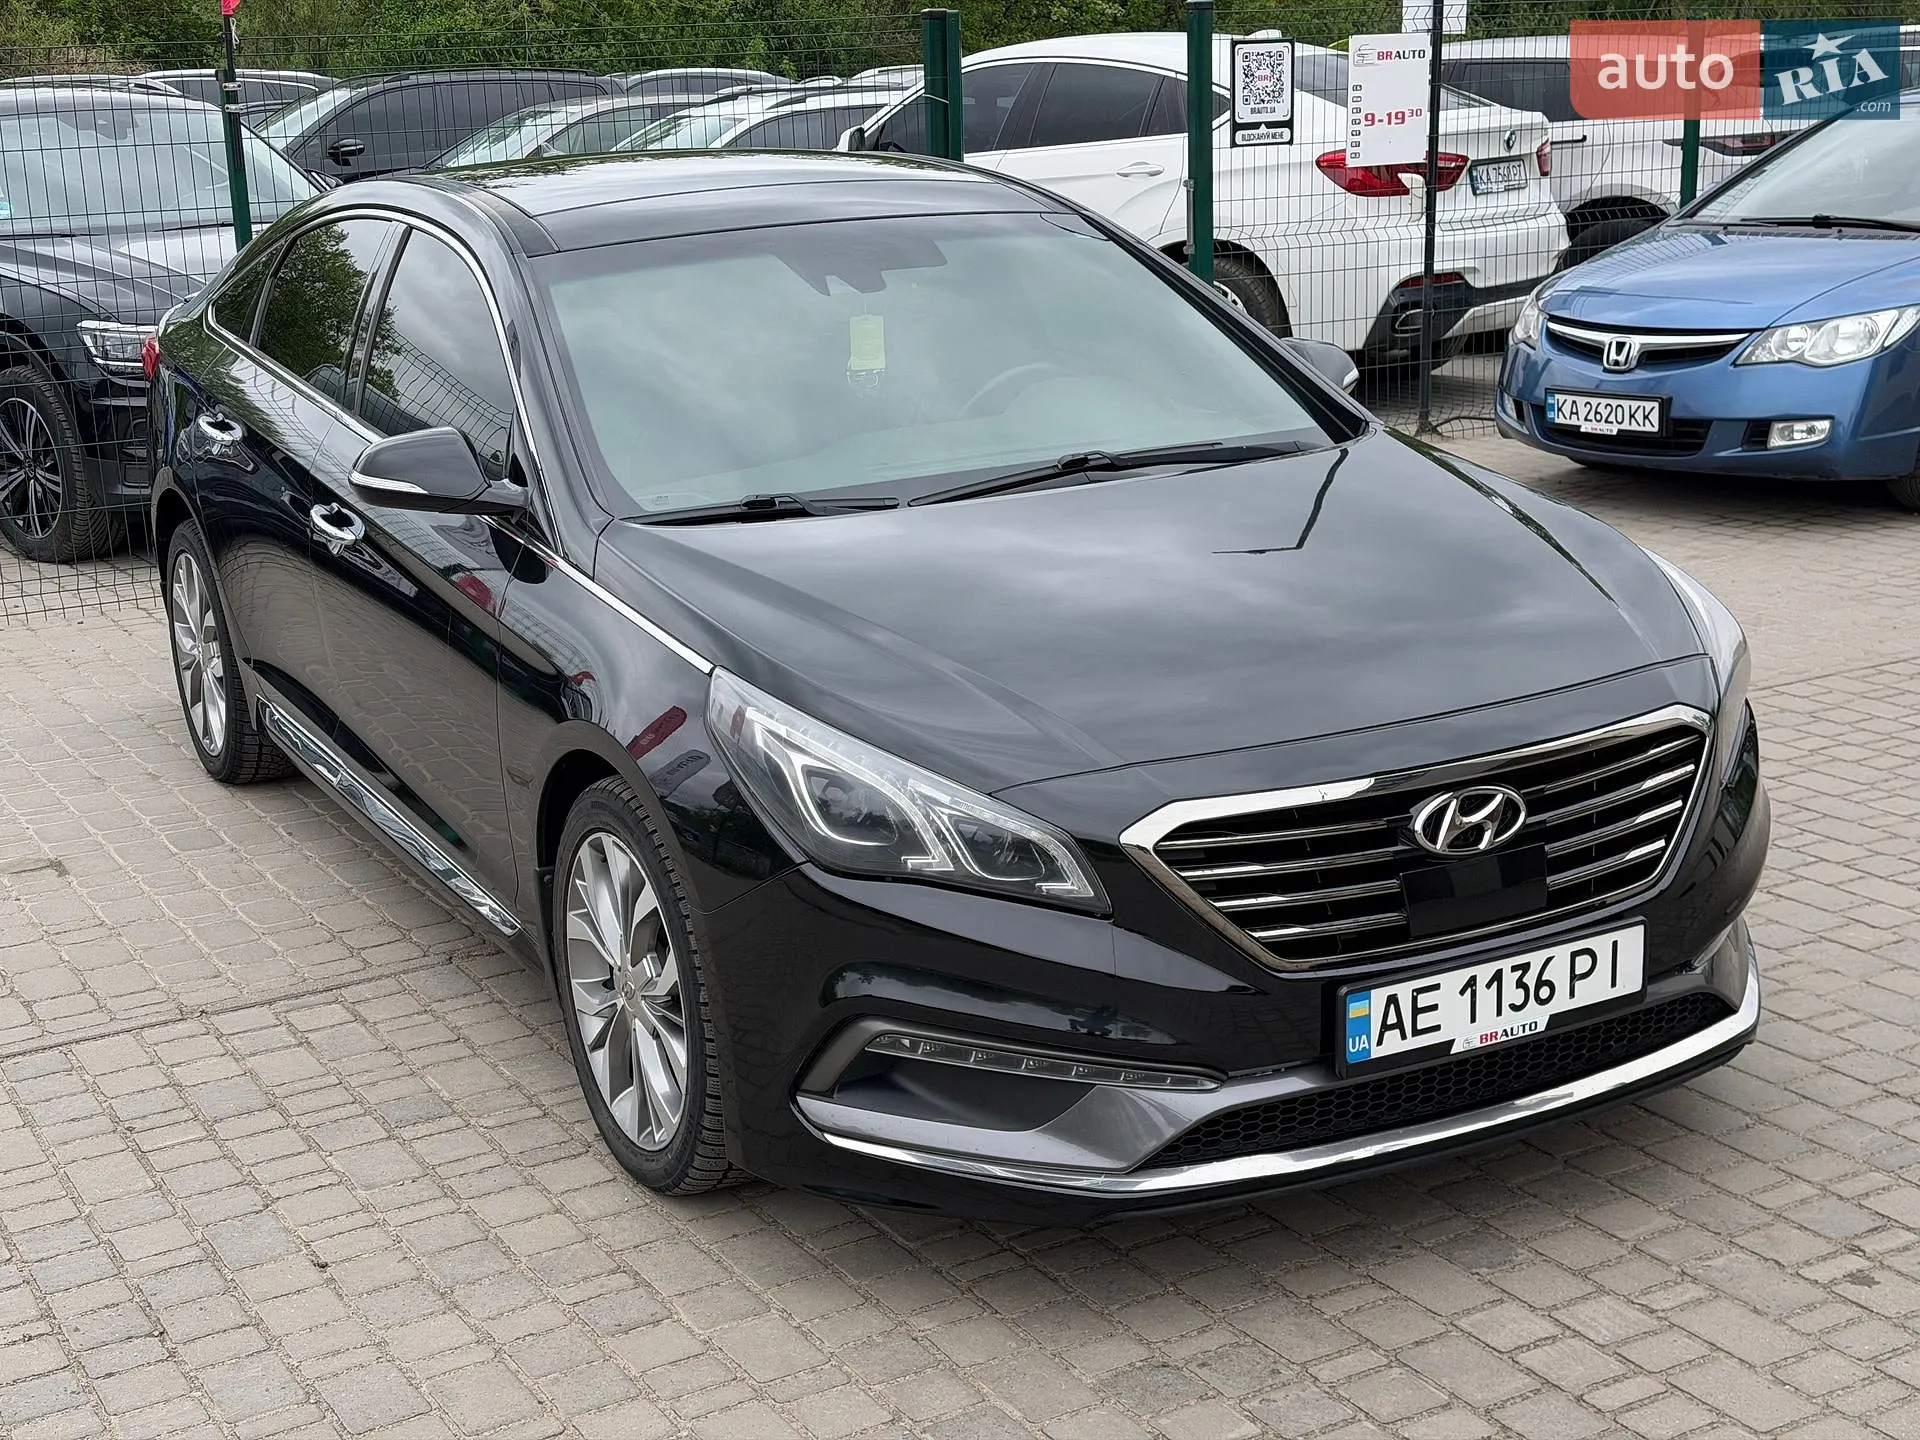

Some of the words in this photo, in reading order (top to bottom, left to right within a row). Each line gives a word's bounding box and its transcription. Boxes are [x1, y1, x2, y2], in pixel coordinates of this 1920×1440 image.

[1377, 49, 1426, 61] BRAUTO
[1556, 398, 1580, 421] KA
[1583, 401, 1625, 425] 2620
[1628, 404, 1656, 428] KK
[1375, 983, 1441, 1048] AE
[1458, 955, 1556, 1024] 1136
[1569, 939, 1619, 1000] PI
[1349, 1034, 1369, 1053] UA
[1479, 1020, 1538, 1045] BRAUTO
